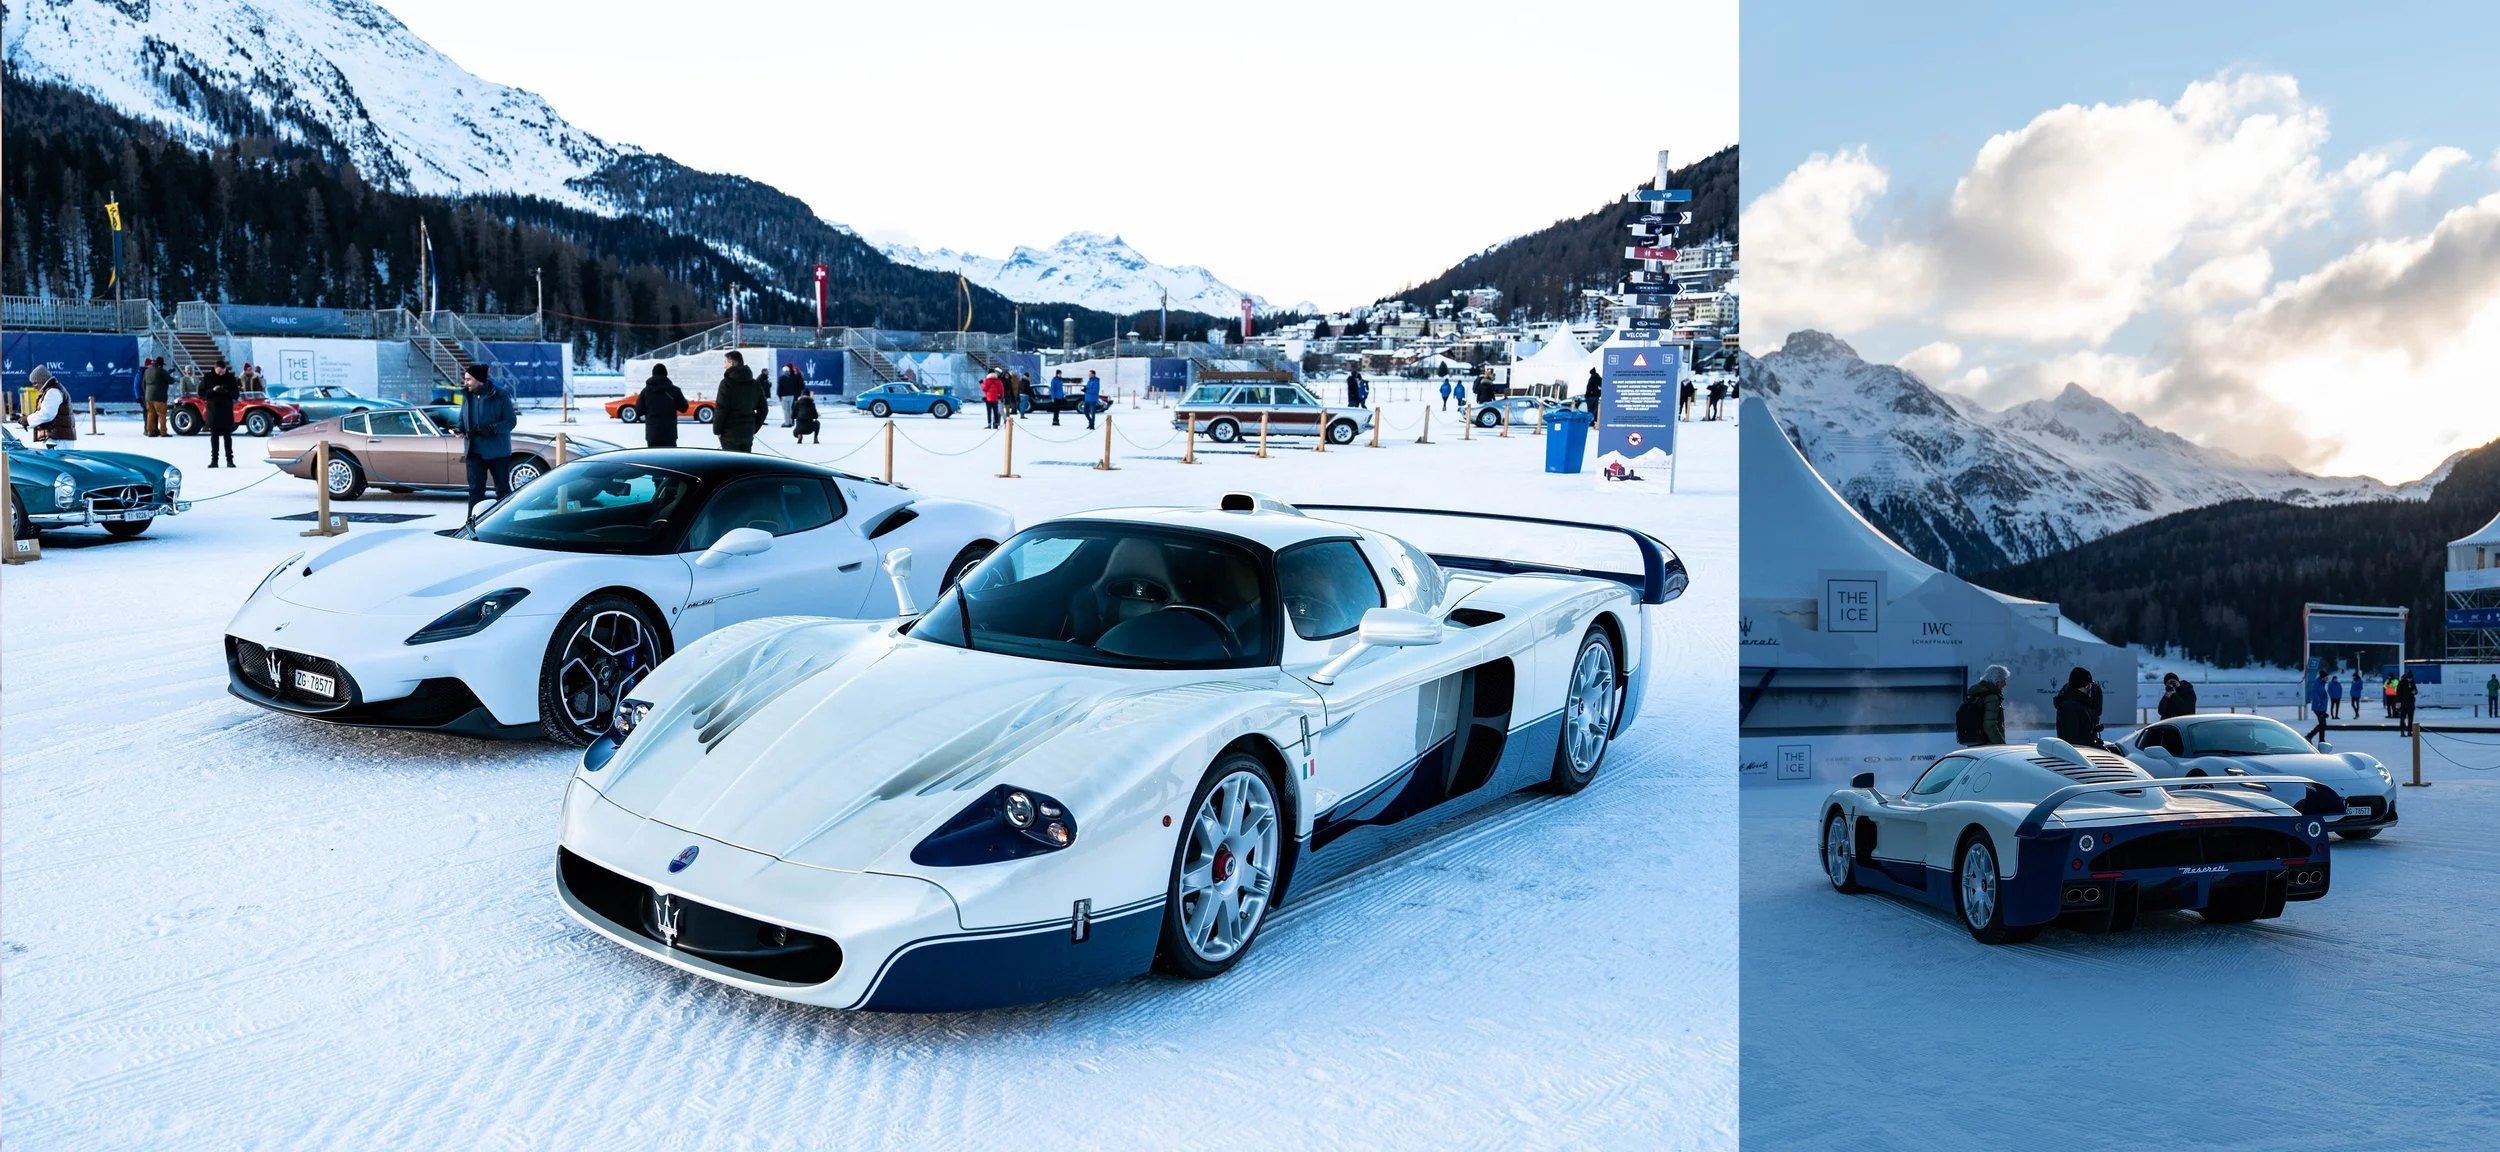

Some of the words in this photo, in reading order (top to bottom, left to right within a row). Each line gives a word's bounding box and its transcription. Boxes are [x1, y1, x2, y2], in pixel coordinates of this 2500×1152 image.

[287, 358, 308, 368] THE
[289, 371, 308, 380] ICE
[1838, 591, 1868, 604] THE
[1841, 608, 1868, 621] ICE
[1922, 622, 1951, 636] IWC
[1784, 752, 1805, 761] THE
[1785, 763, 1805, 772] ICE
[2178, 865, 2229, 875] Maserati
